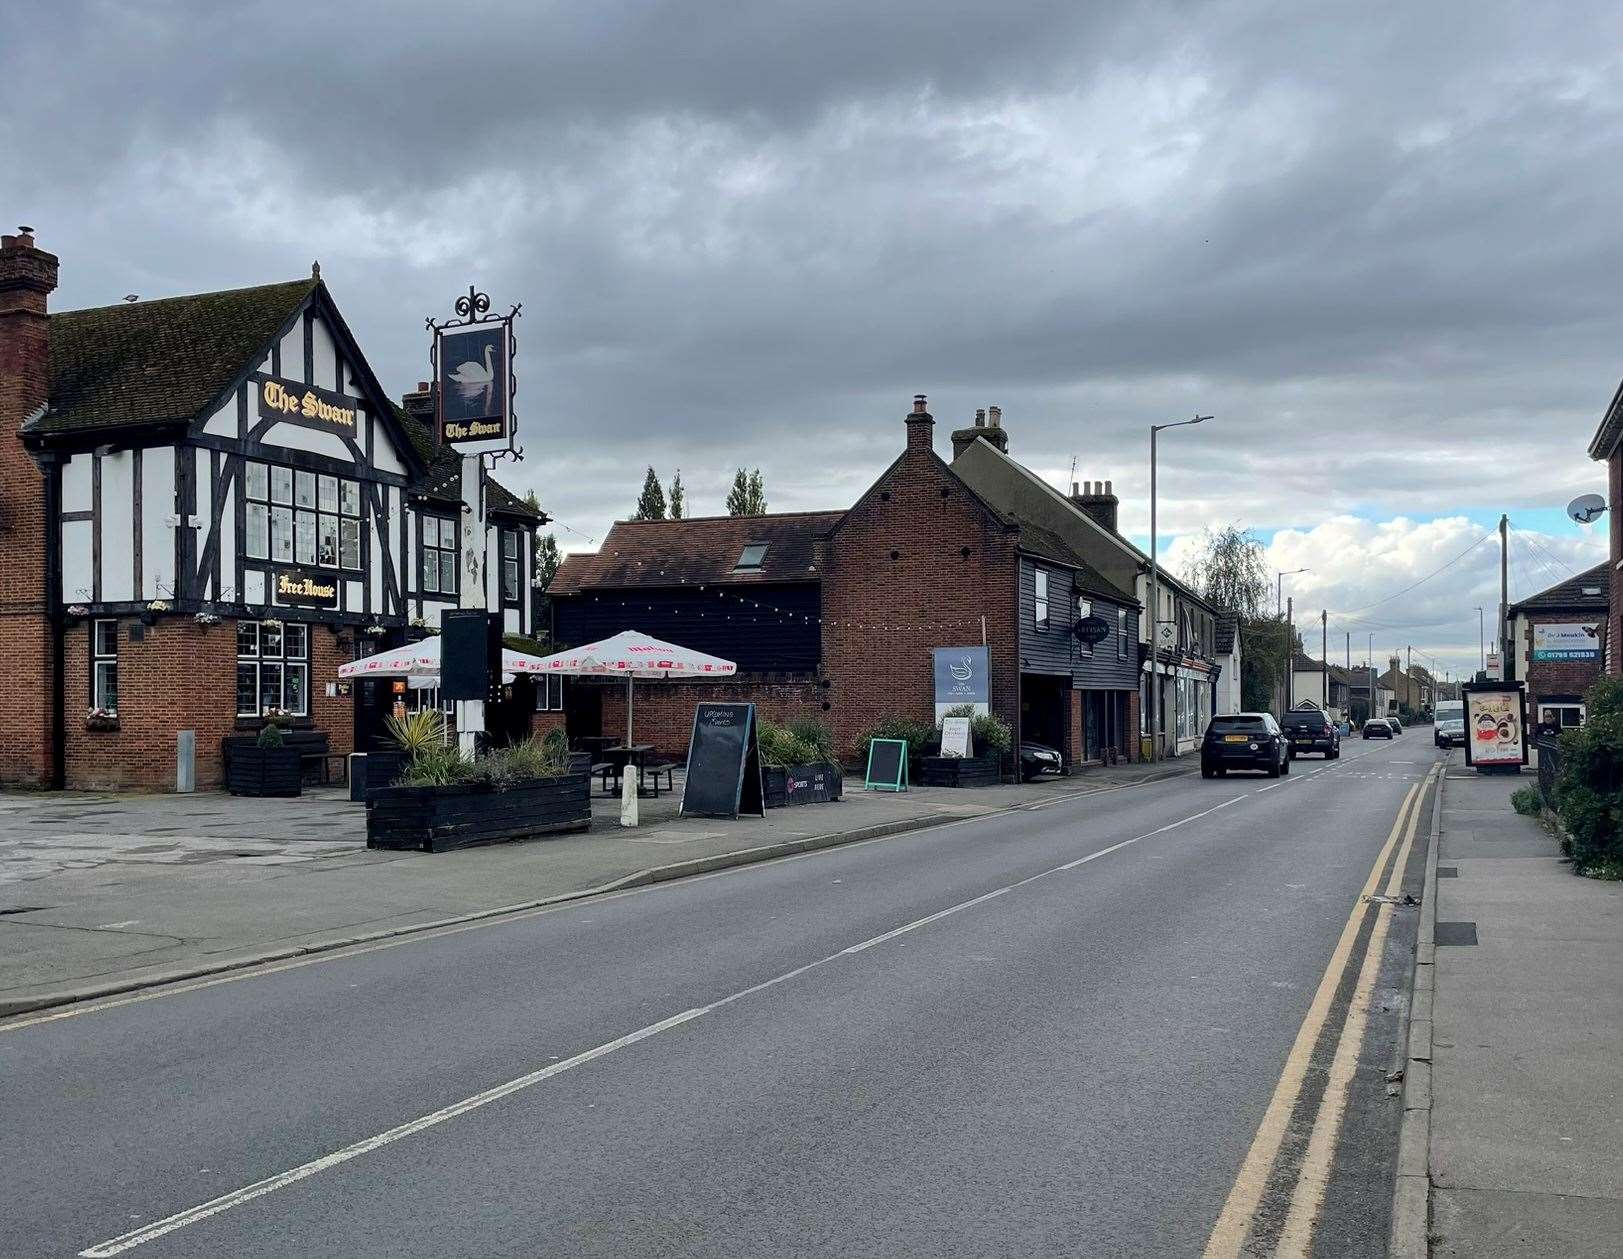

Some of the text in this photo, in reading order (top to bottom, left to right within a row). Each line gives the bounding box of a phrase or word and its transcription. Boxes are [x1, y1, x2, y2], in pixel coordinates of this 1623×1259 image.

[264, 381, 354, 426] The Swan
[445, 421, 501, 439] The Swan
[278, 574, 335, 598] Free House
